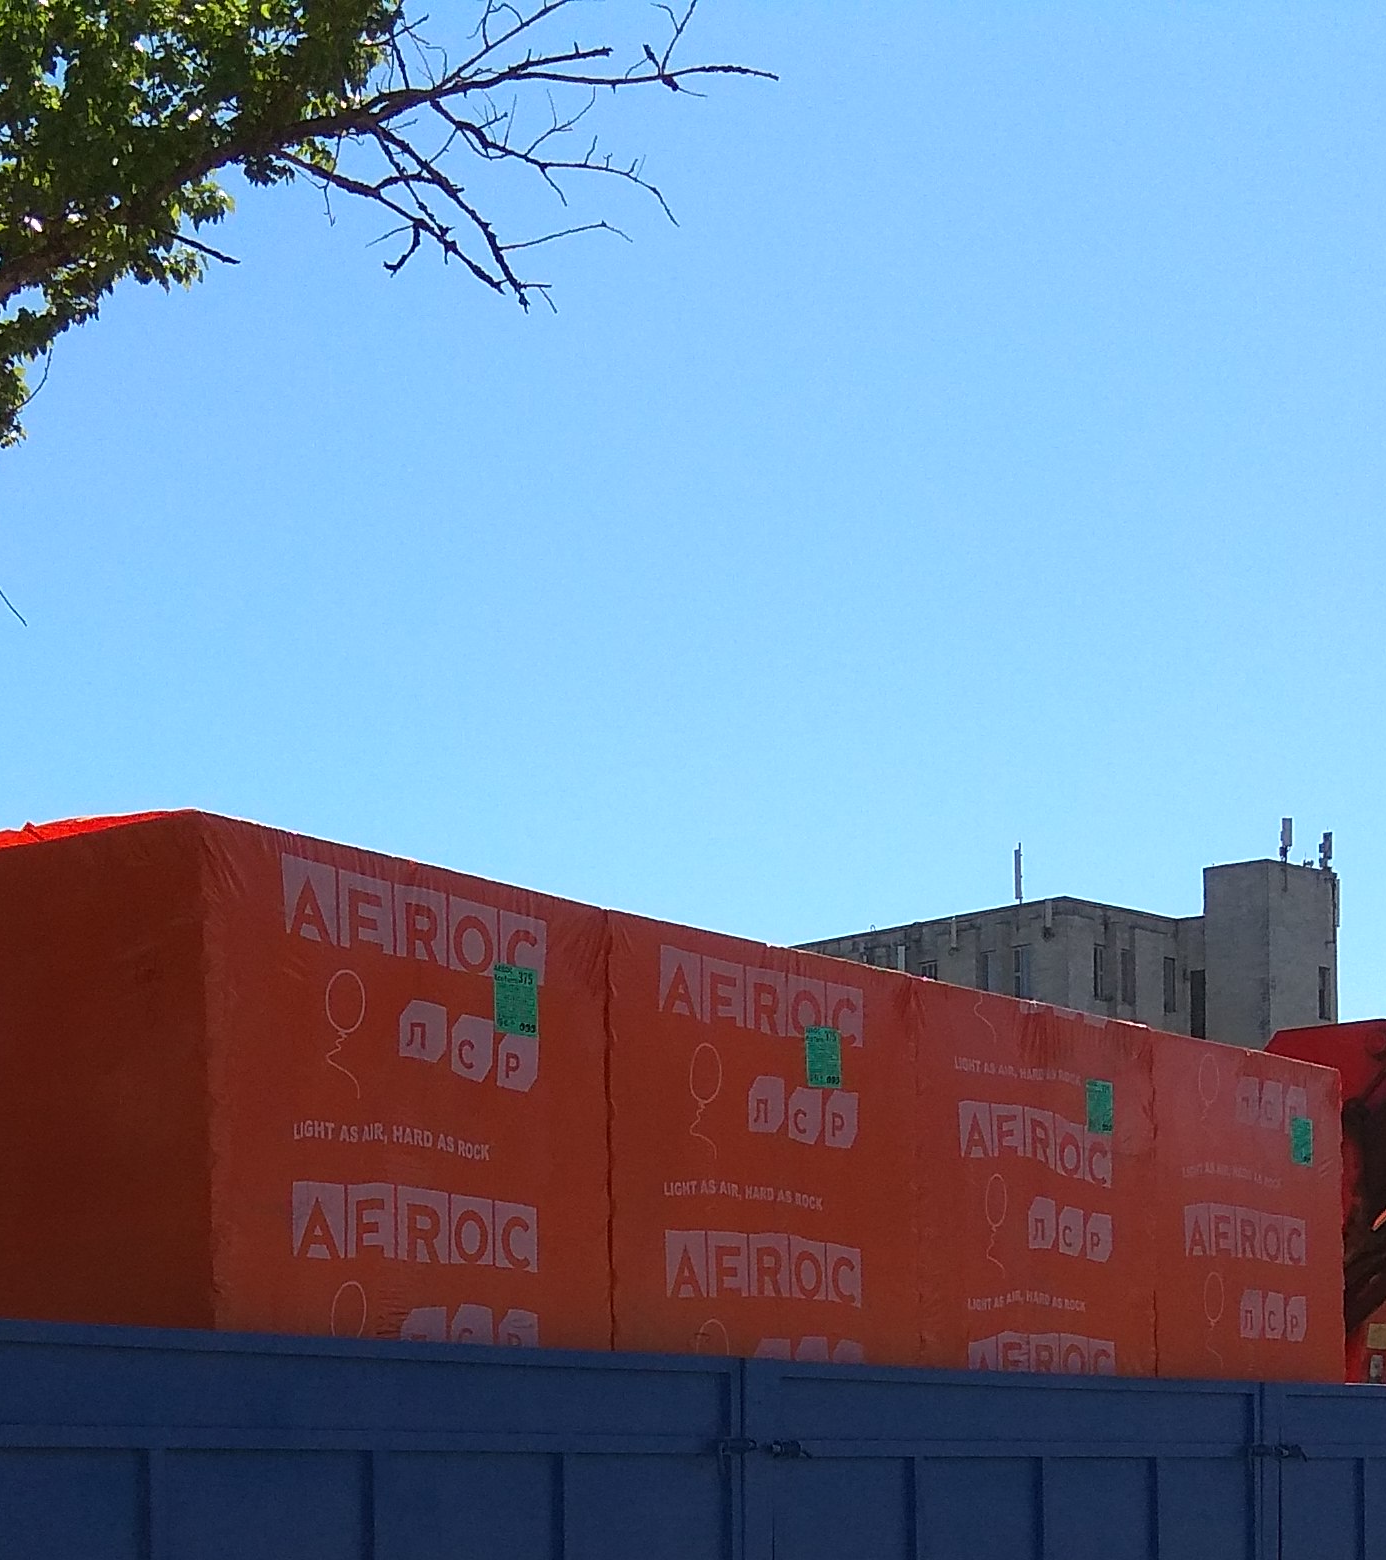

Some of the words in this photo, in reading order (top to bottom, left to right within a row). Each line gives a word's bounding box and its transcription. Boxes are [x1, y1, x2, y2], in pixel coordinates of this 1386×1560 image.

[285, 865, 541, 975] AEROC
[661, 957, 859, 1046] AEROC
[293, 1120, 335, 1140] LIGHT
[339, 1125, 358, 1142] AS
[363, 1122, 388, 1144] AIR,
[392, 1125, 432, 1147] HARD
[437, 1134, 454, 1153] AS
[458, 1140, 490, 1160] ROCK
[961, 1107, 1109, 1186] AEROC
[295, 1190, 534, 1271] AEROC
[664, 1181, 697, 1196] LIGHT
[701, 1179, 716, 1194] AS
[720, 1181, 742, 1200] AIR,
[745, 1185, 774, 1201] HARD
[777, 1190, 792, 1204] AS
[795, 1192, 823, 1211] ROCK
[668, 1239, 859, 1307] AEROC
[1187, 1211, 1303, 1264] AEROC
